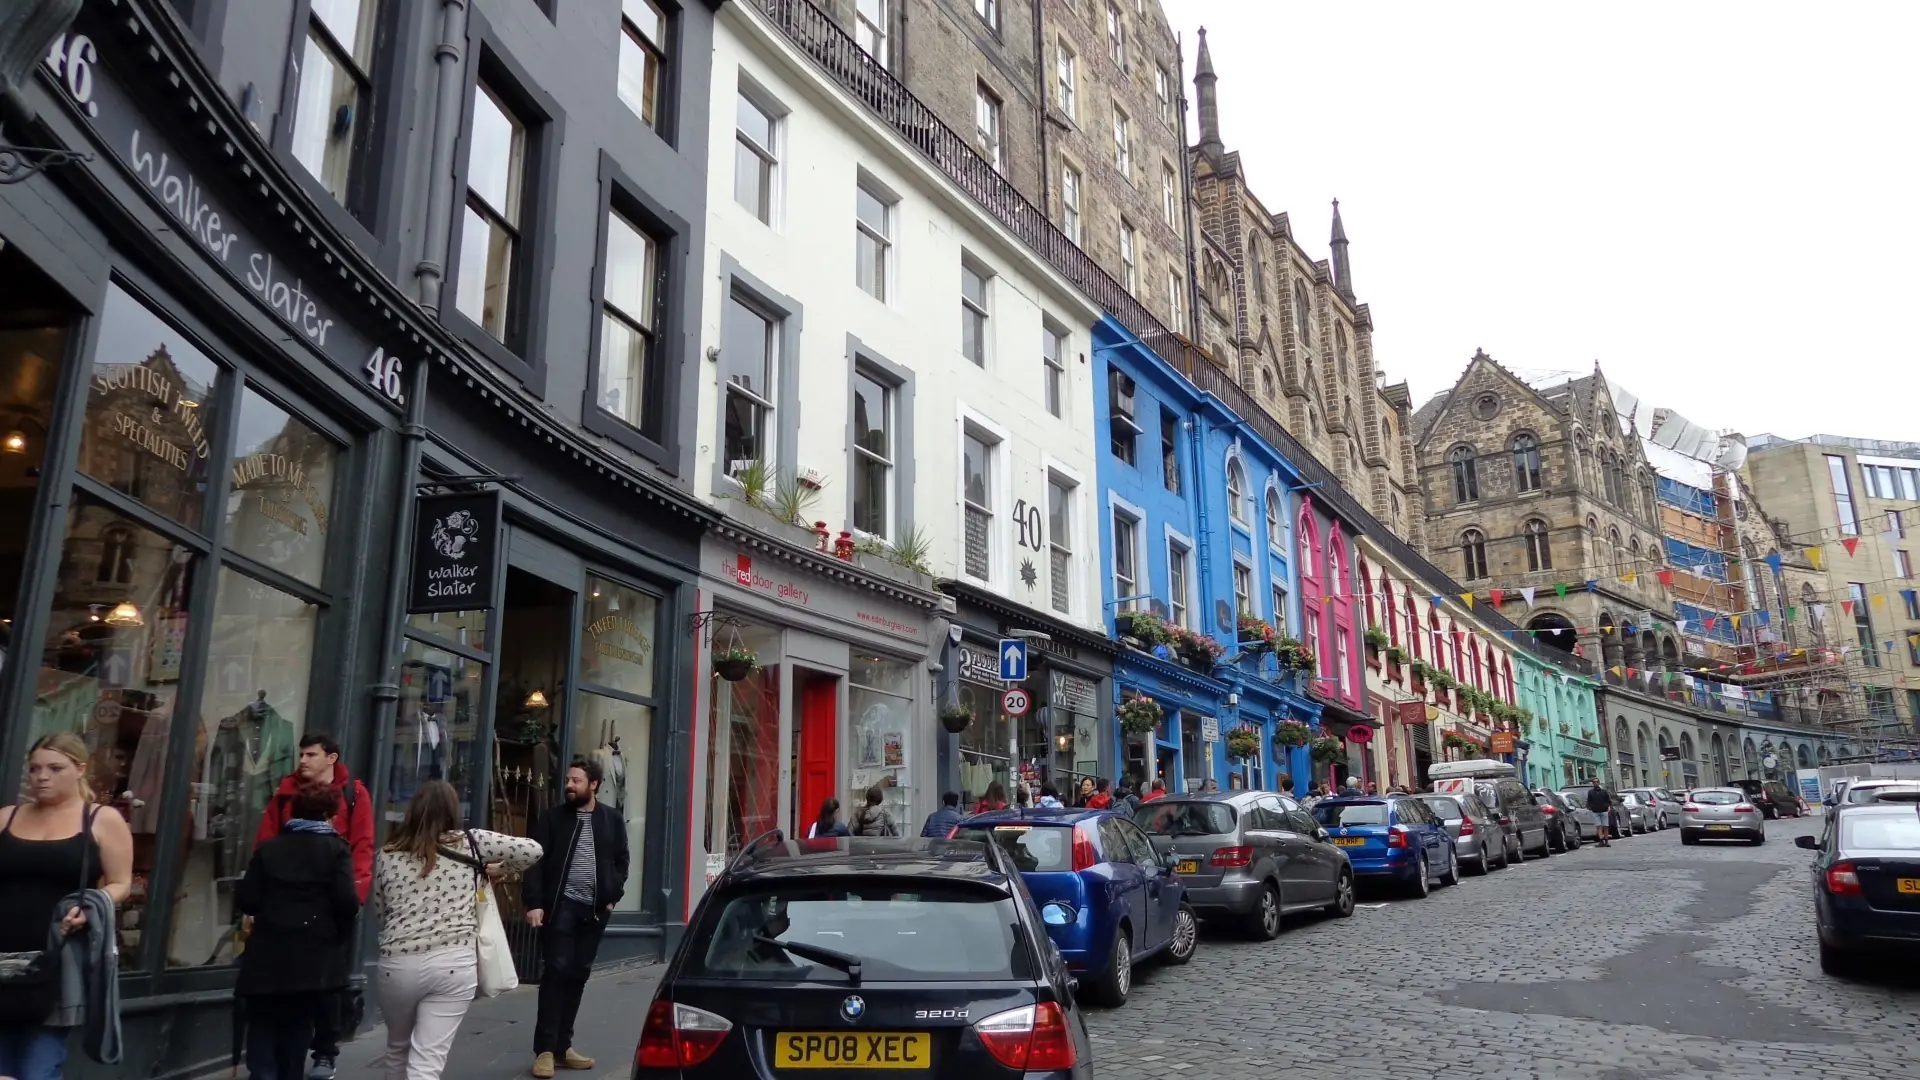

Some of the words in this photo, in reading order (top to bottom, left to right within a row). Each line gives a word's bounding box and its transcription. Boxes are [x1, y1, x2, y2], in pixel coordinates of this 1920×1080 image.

[131, 128, 238, 262] Walker
[247, 252, 334, 347] Slater
[97, 363, 172, 404] SCOTTISH
[174, 390, 209, 459] TWEED
[151, 406, 163, 425] &
[114, 411, 189, 471] SPECIALITIES
[232, 453, 269, 489] MADE
[270, 453, 286, 478] TO
[1012, 498, 1042, 553] 40
[721, 557, 737, 576] the
[737, 567, 751, 583] red
[752, 570, 774, 590] door
[777, 582, 809, 605] gallery
[959, 648, 971, 677] 2
[972, 651, 1000, 672] FLOOR
[1006, 696, 1026, 708] 20
[914, 1009, 969, 1018] 320d
[788, 1035, 858, 1062] SP08
[866, 1035, 918, 1062] XEC
